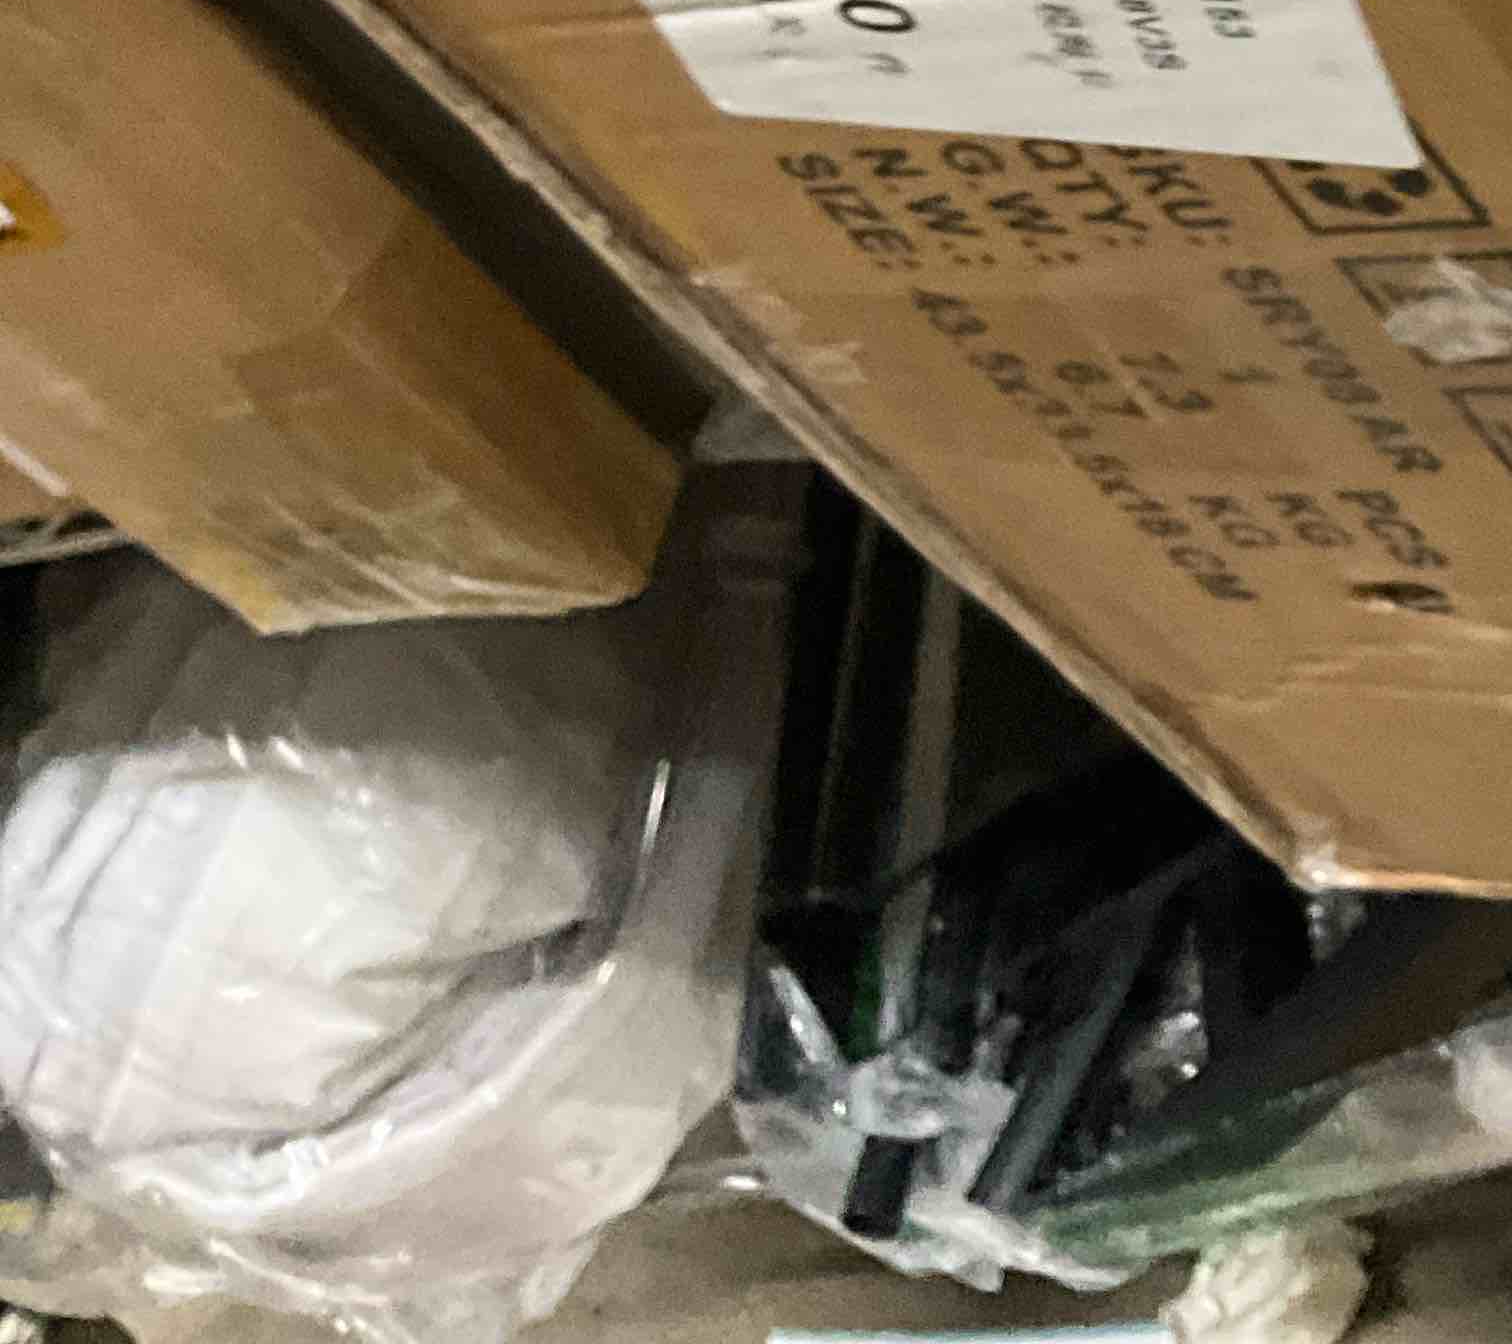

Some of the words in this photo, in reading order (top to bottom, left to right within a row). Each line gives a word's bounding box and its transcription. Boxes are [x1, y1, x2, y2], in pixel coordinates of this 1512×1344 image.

[776, 152, 923, 270] SIZE:
[1187, 495, 1284, 549] KG
[1265, 491, 1356, 548] KG
[1334, 488, 1452, 569] PCS
